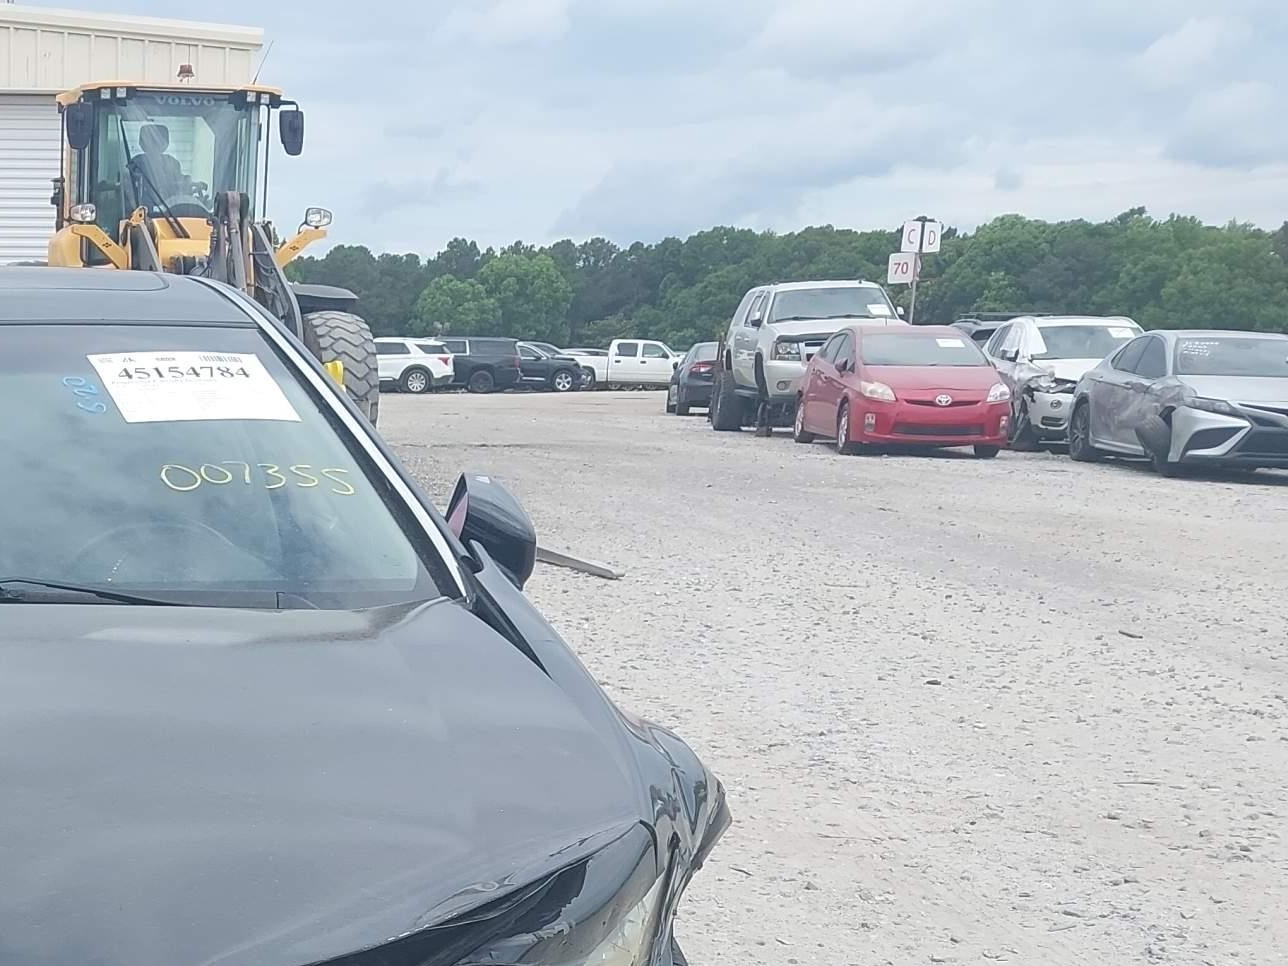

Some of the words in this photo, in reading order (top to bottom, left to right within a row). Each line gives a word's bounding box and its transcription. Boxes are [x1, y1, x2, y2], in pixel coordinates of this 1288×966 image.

[153, 95, 216, 106] VOLVO
[907, 229, 916, 244] C
[927, 230, 937, 245] D
[893, 262, 909, 275] 70
[118, 366, 250, 380] 45154784
